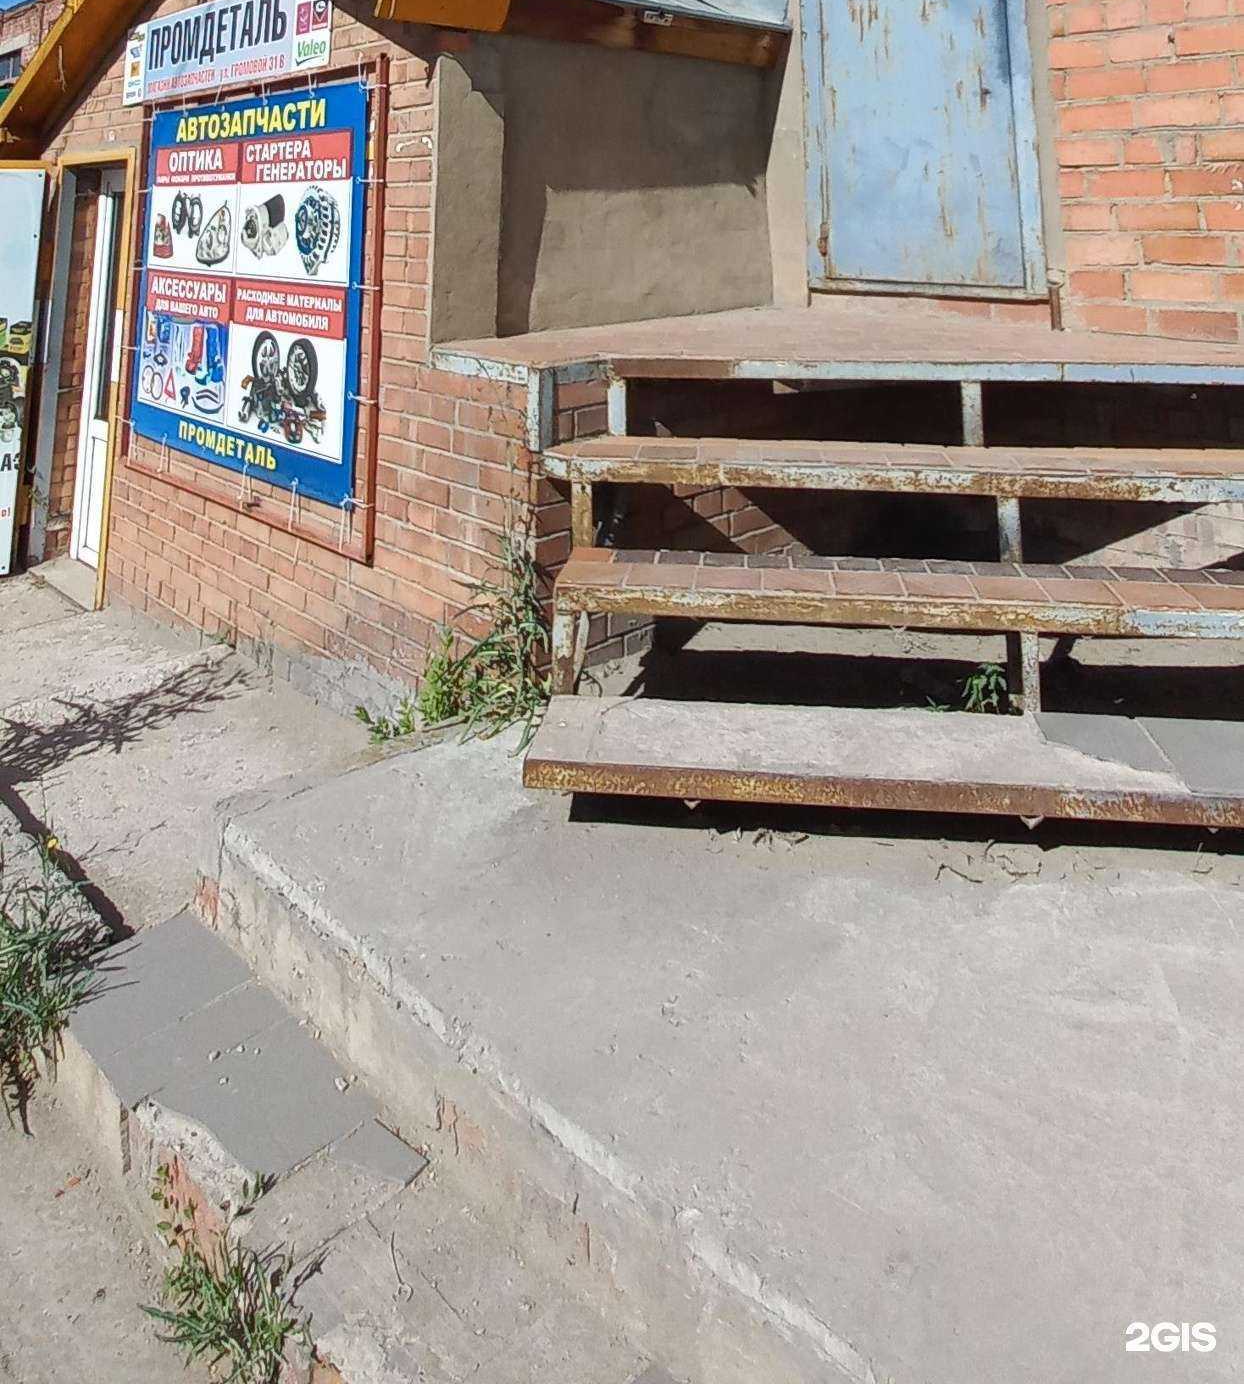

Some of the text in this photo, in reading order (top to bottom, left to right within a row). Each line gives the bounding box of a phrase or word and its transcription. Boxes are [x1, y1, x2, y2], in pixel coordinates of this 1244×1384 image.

[298, 40, 326, 57] Valeo
[176, 98, 326, 143] АВТОЗАПЧАСТИ
[169, 148, 222, 172] ОПТИКА
[246, 139, 311, 162] СТАРТЕРА
[255, 158, 346, 182] ГЕНЕРАТОРЫ
[151, 276, 226, 303] АКСЕССУАРЫ
[236, 288, 342, 313] РАСХОДНЫЕ МАТЕРИАЛЫ
[155, 299, 218, 319] ДЛЯ ВАШЕГО АВТО
[245, 307, 329, 331] ДЛЯ АВТОМОБИЛЯ
[178, 420, 276, 471] ПРОМДЕТАЛЬ
